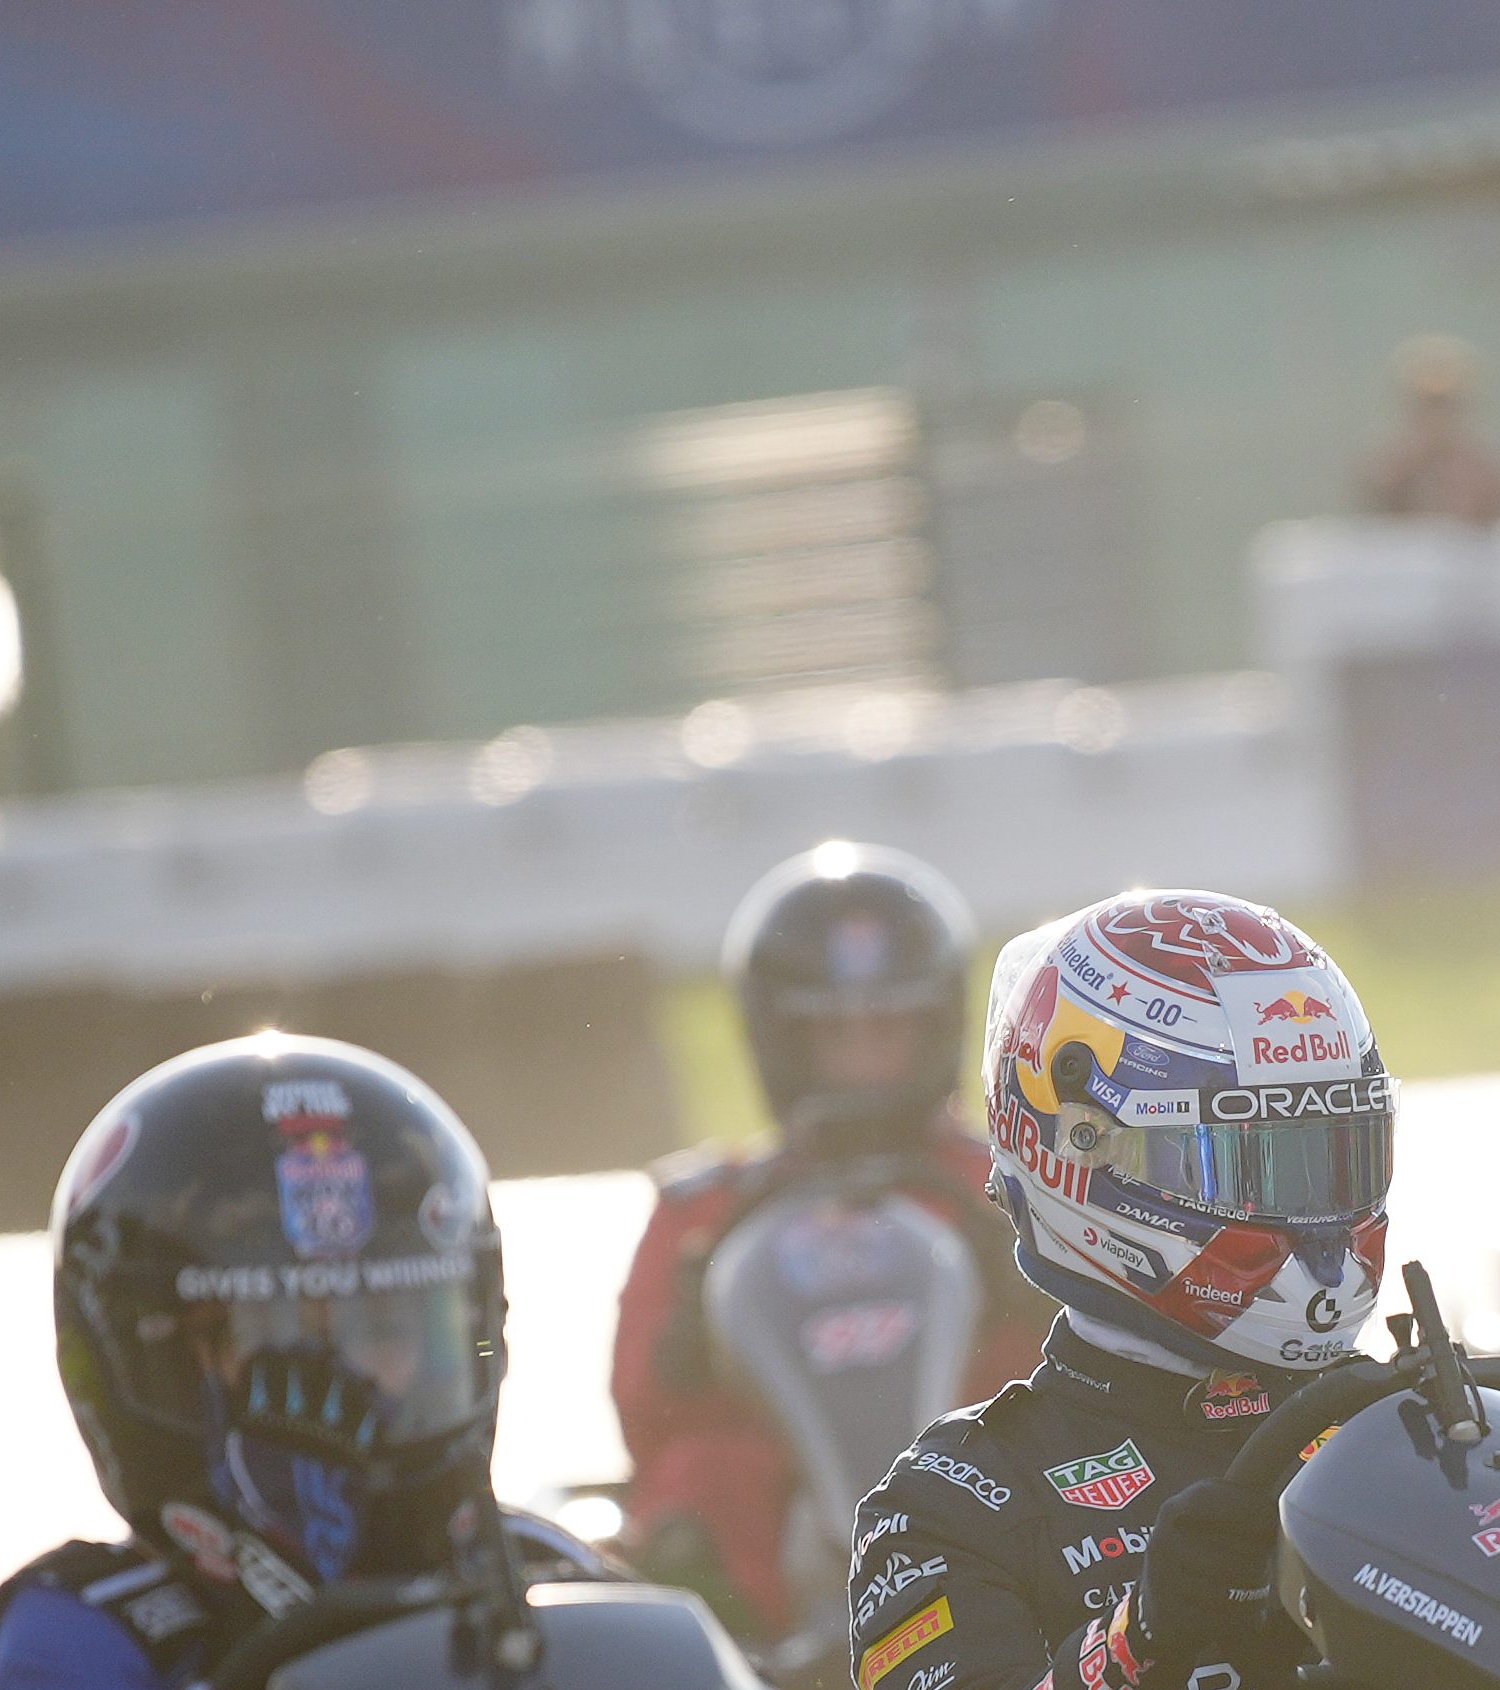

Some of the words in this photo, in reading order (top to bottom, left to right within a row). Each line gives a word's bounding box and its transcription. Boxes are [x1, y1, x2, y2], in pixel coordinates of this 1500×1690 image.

[1131, 1044, 1163, 1064] Ford
[1253, 1033, 1308, 1065] Red
[1309, 1030, 1352, 1061] Bull
[1119, 1056, 1169, 1079] RACING
[1092, 1075, 1122, 1109] VISA
[1136, 1102, 1175, 1116] Mobil
[1211, 1079, 1384, 1120] ORACLE
[1017, 1108, 1090, 1206] Bull
[1116, 1202, 1185, 1233] DAMAC
[1100, 1238, 1145, 1268] viaplay
[175, 1266, 274, 1301] GIVES
[278, 1260, 361, 1298] YOU
[1183, 1277, 1243, 1305] indeed
[1201, 1401, 1239, 1420] Red
[1239, 1392, 1271, 1416] Bull
[912, 1451, 1012, 1511] sparco
[1053, 1449, 1137, 1486] TAG
[1065, 1469, 1149, 1506] HEUER
[1061, 1526, 1155, 1576] Mobi
